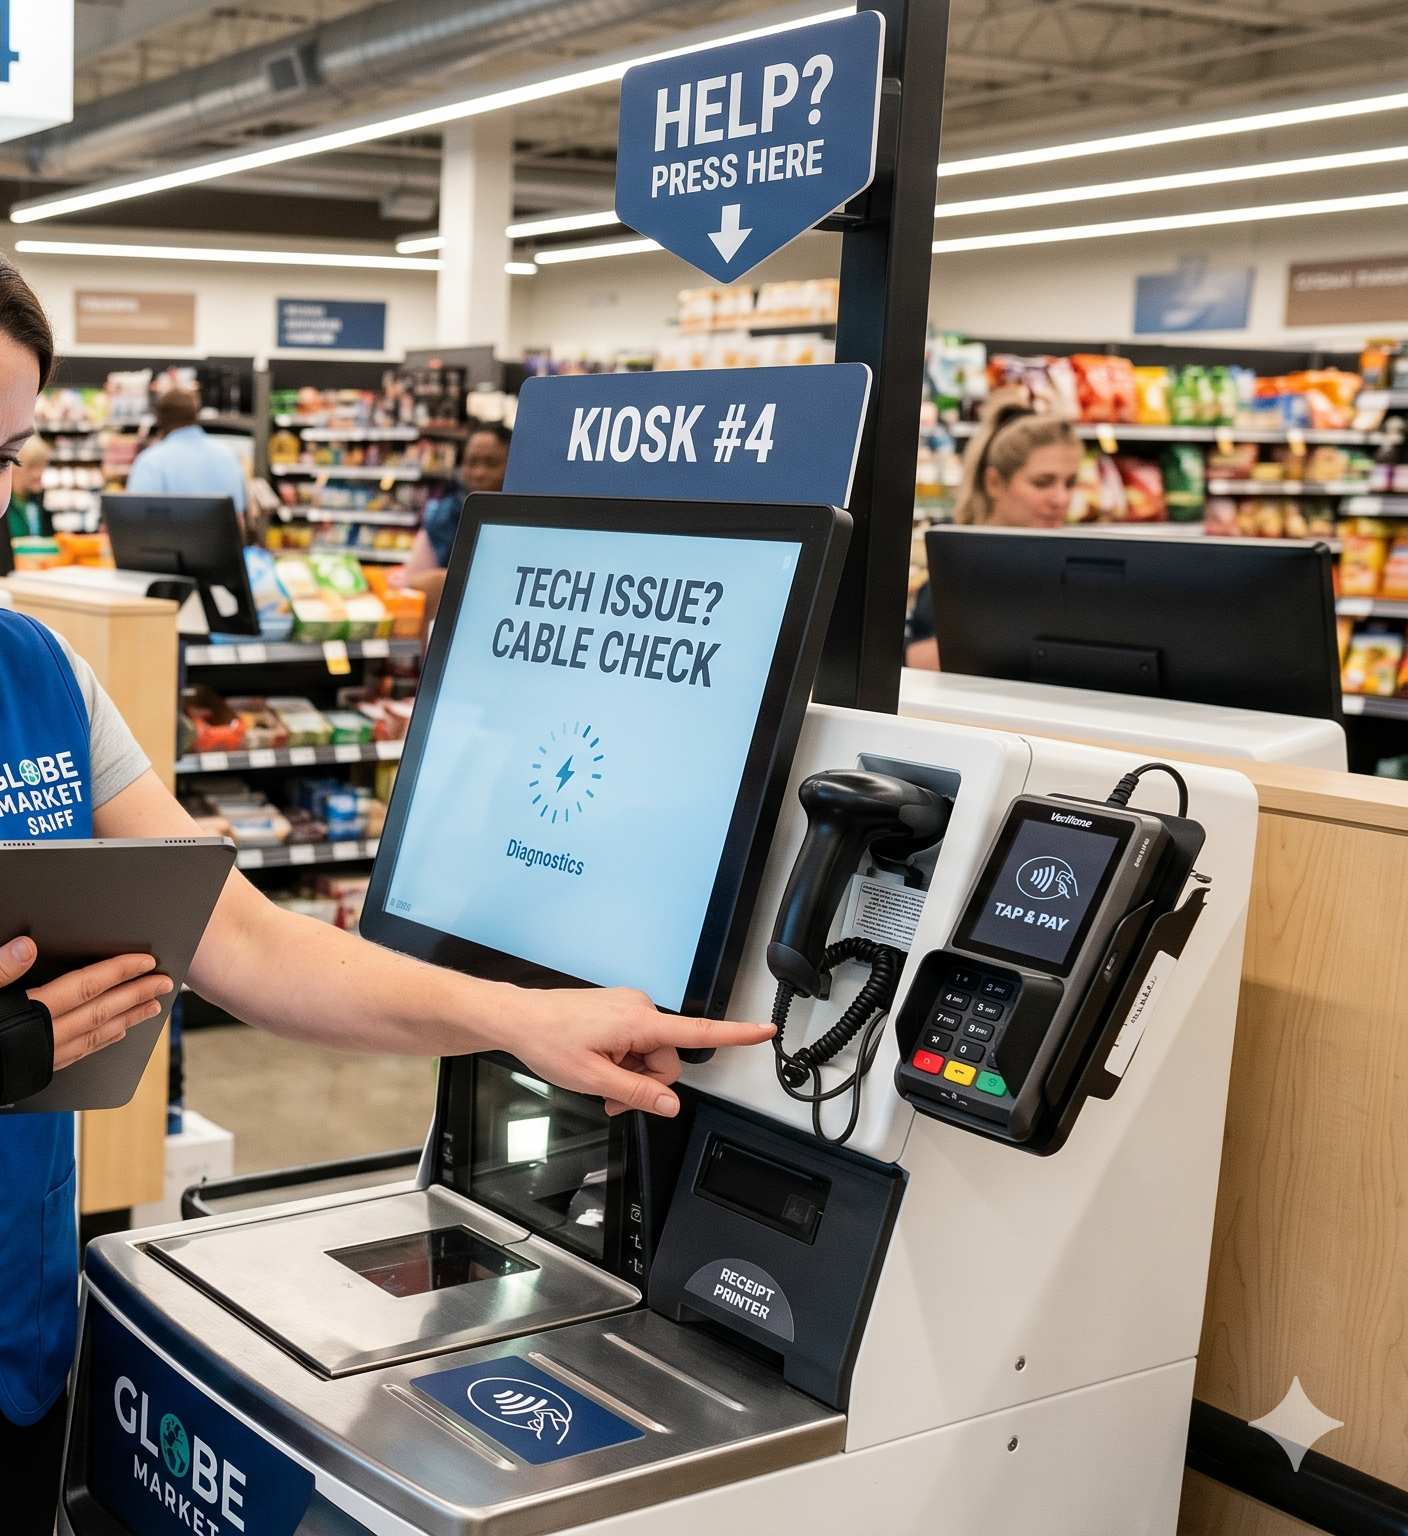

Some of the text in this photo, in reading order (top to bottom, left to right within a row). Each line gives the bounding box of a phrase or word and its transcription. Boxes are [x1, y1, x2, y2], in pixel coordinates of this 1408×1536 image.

[654, 54, 834, 152] HELP?
[651, 139, 825, 198] PRESS HERE
[567, 403, 777, 463] KIOSK #4
[514, 566, 724, 626] TECH ISSUE?
[492, 618, 722, 688] CABLE CHECK
[506, 838, 585, 875] Diagnostics
[994, 902, 1070, 931] TAP & PAY
[960, 1046, 967, 1054] 0
[968, 1024, 976, 1032] 9
[713, 1284, 770, 1320] PRINTER
[719, 1267, 776, 1302] RECEIPT
[114, 1375, 247, 1533] GLOBE
[133, 1454, 220, 1536] MARKET
